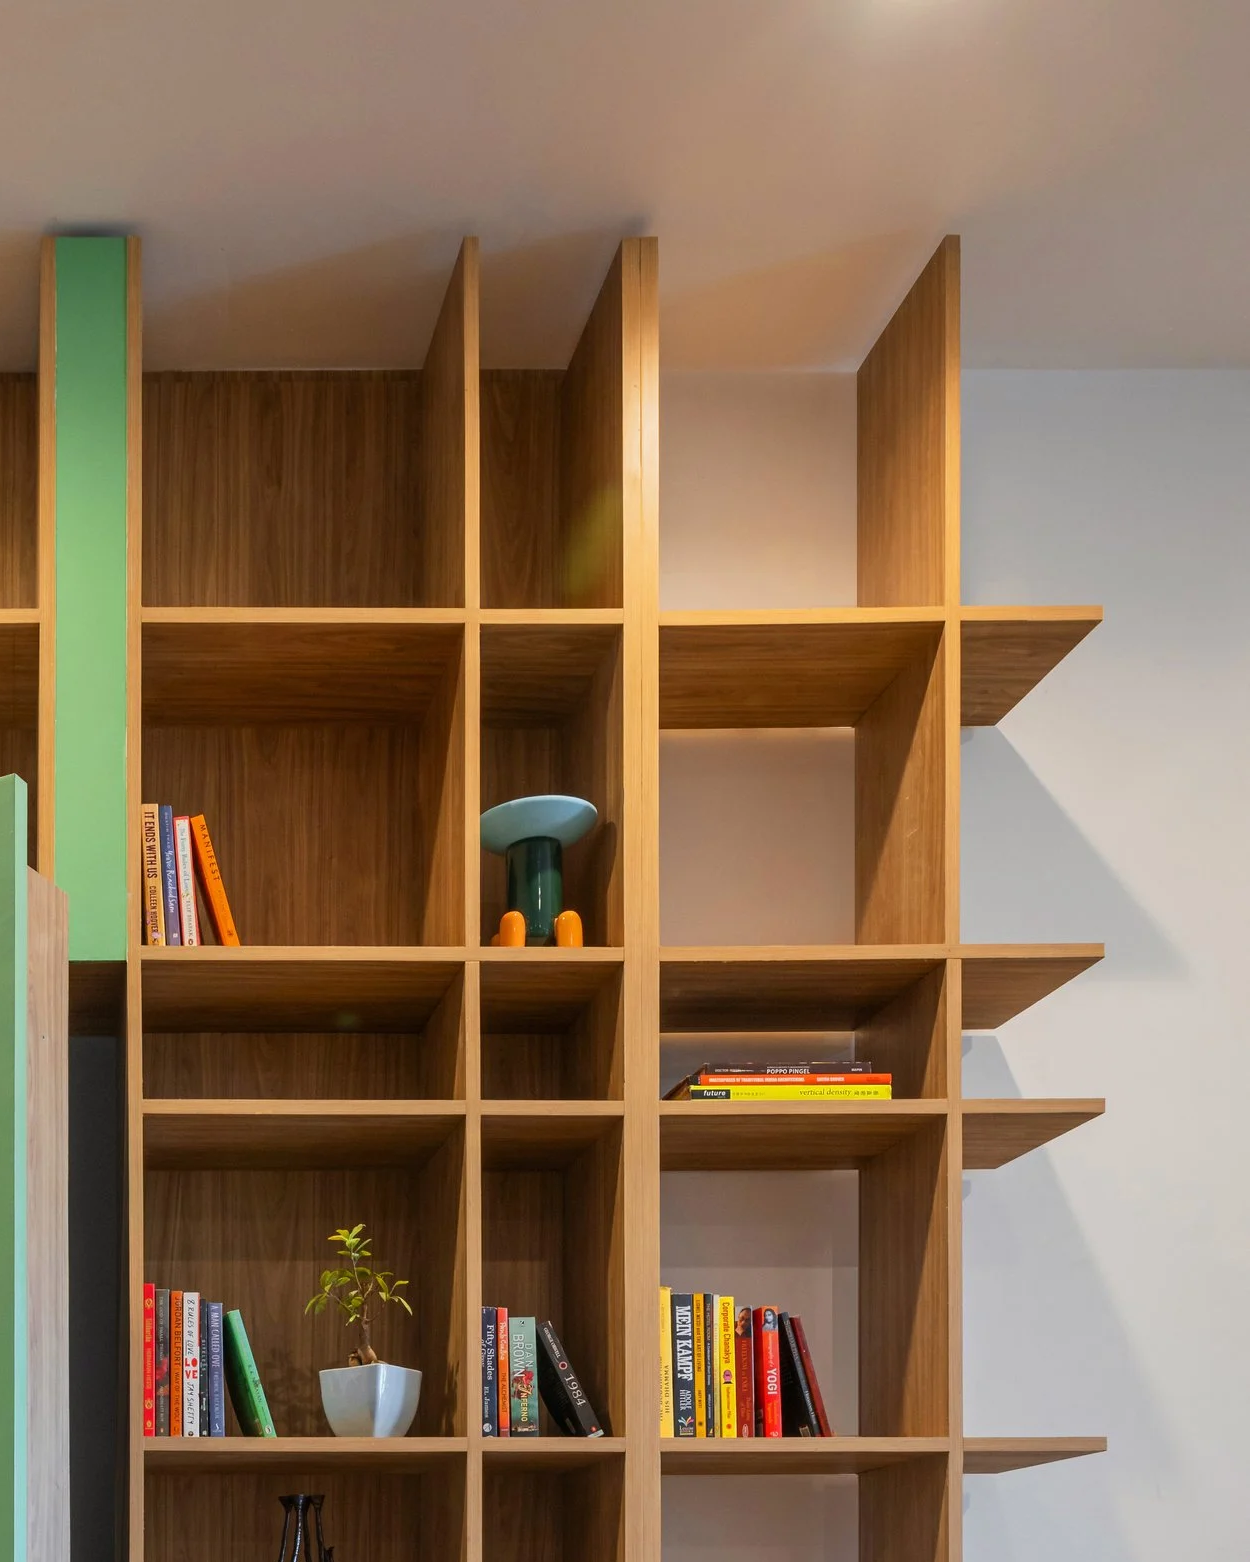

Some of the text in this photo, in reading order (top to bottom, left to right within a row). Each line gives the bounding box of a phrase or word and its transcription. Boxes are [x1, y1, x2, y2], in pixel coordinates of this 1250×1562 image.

[145, 822, 156, 842] ENDS
[146, 845, 157, 865] WITH
[200, 824, 220, 882] MANIFEST
[147, 868, 158, 878] US
[150, 911, 158, 932] HOOVER
[826, 1088, 853, 1097] density
[211, 1312, 219, 1327] MAN
[212, 1329, 220, 1353] CALLED
[485, 1324, 494, 1346] Fifty
[676, 1305, 693, 1381] MEIN KAMPF
[721, 1302, 731, 1364] Corporate Chanakya
[212, 1355, 220, 1368] OVE
[512, 1334, 525, 1377] BROWN
[524, 1343, 533, 1367] DAN
[564, 1373, 587, 1407] 1984
[767, 1368, 777, 1395] YOGI
[186, 1398, 194, 1425] SHETTY
